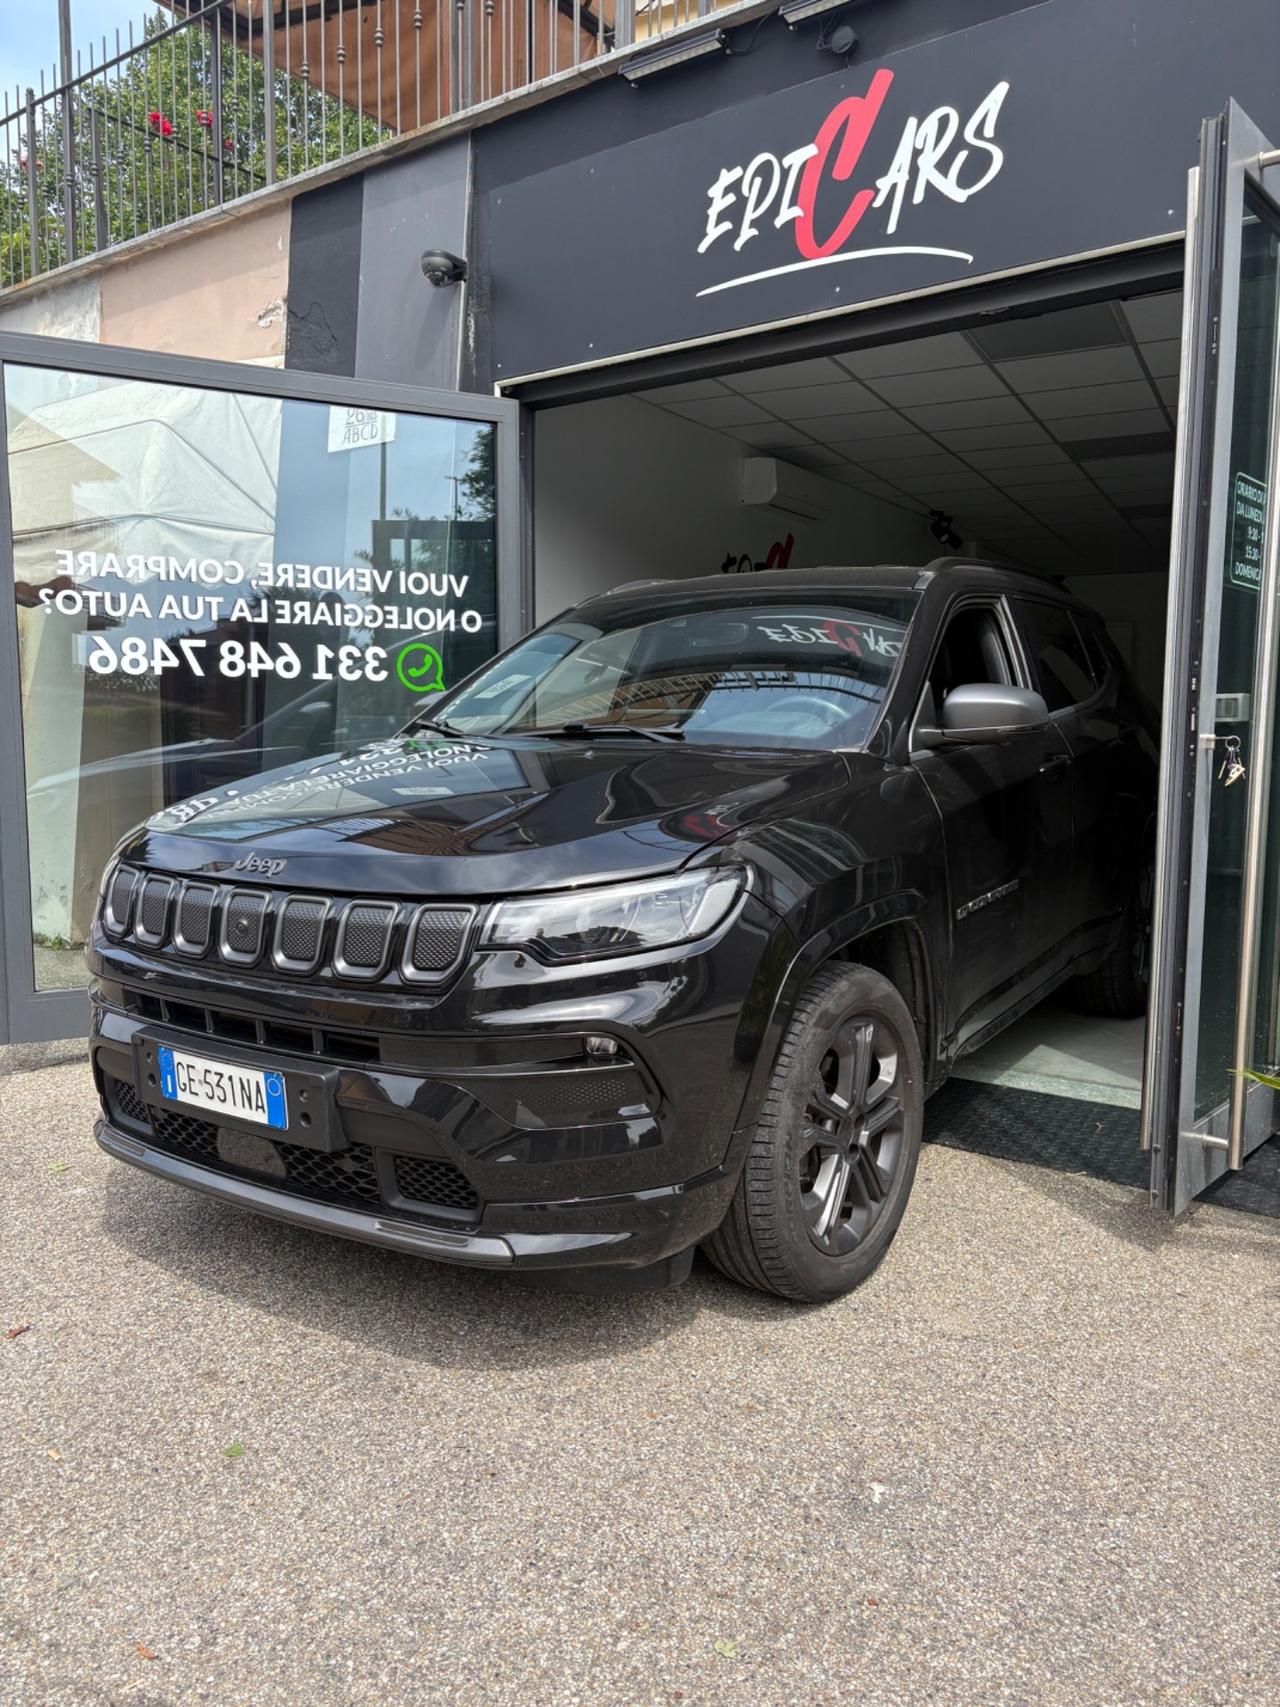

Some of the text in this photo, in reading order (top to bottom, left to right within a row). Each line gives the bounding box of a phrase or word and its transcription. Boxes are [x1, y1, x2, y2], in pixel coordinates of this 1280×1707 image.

[697, 68, 1010, 260] EPICARS
[342, 423, 379, 445] ABCD
[233, 851, 288, 879] Jeep
